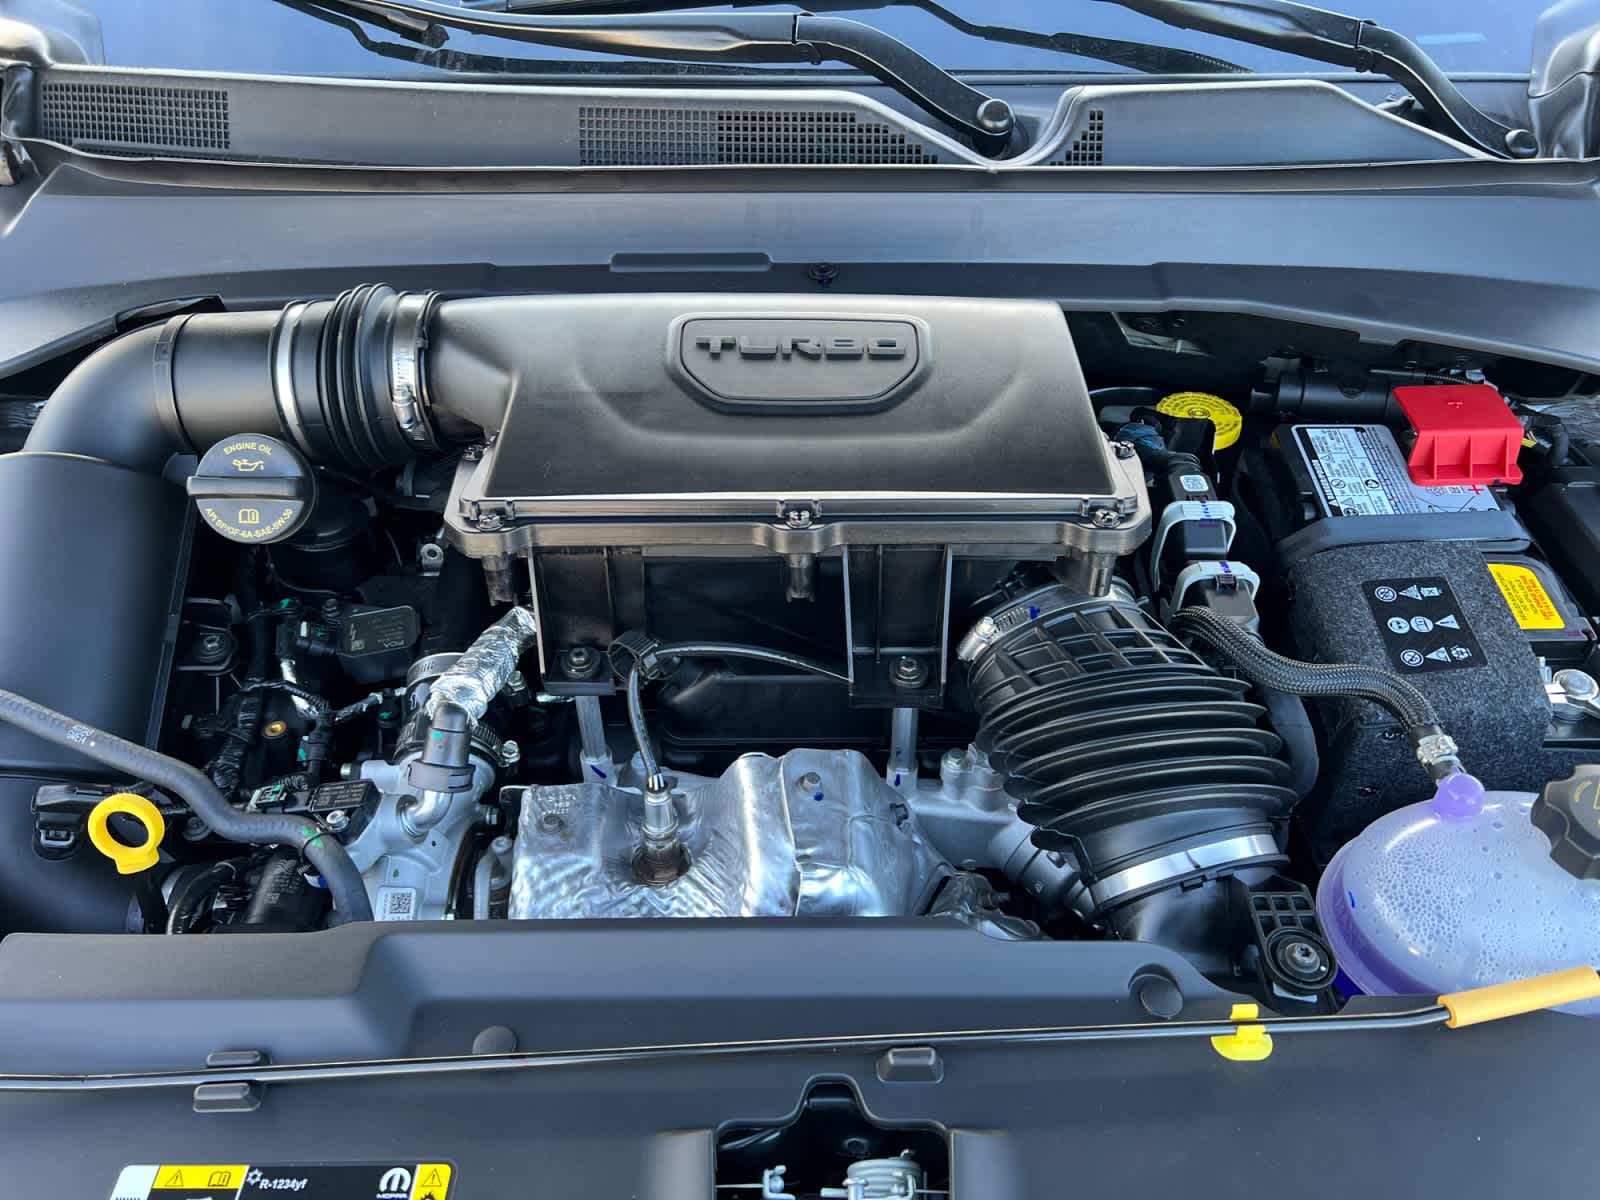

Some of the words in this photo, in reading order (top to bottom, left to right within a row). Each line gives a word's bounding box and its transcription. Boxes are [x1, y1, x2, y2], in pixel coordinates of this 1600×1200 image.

[695, 335, 905, 360] TURBO
[223, 441, 257, 456] ENGINE
[258, 444, 273, 456] OIL
[259, 1178, 308, 1191] R-1234yf
